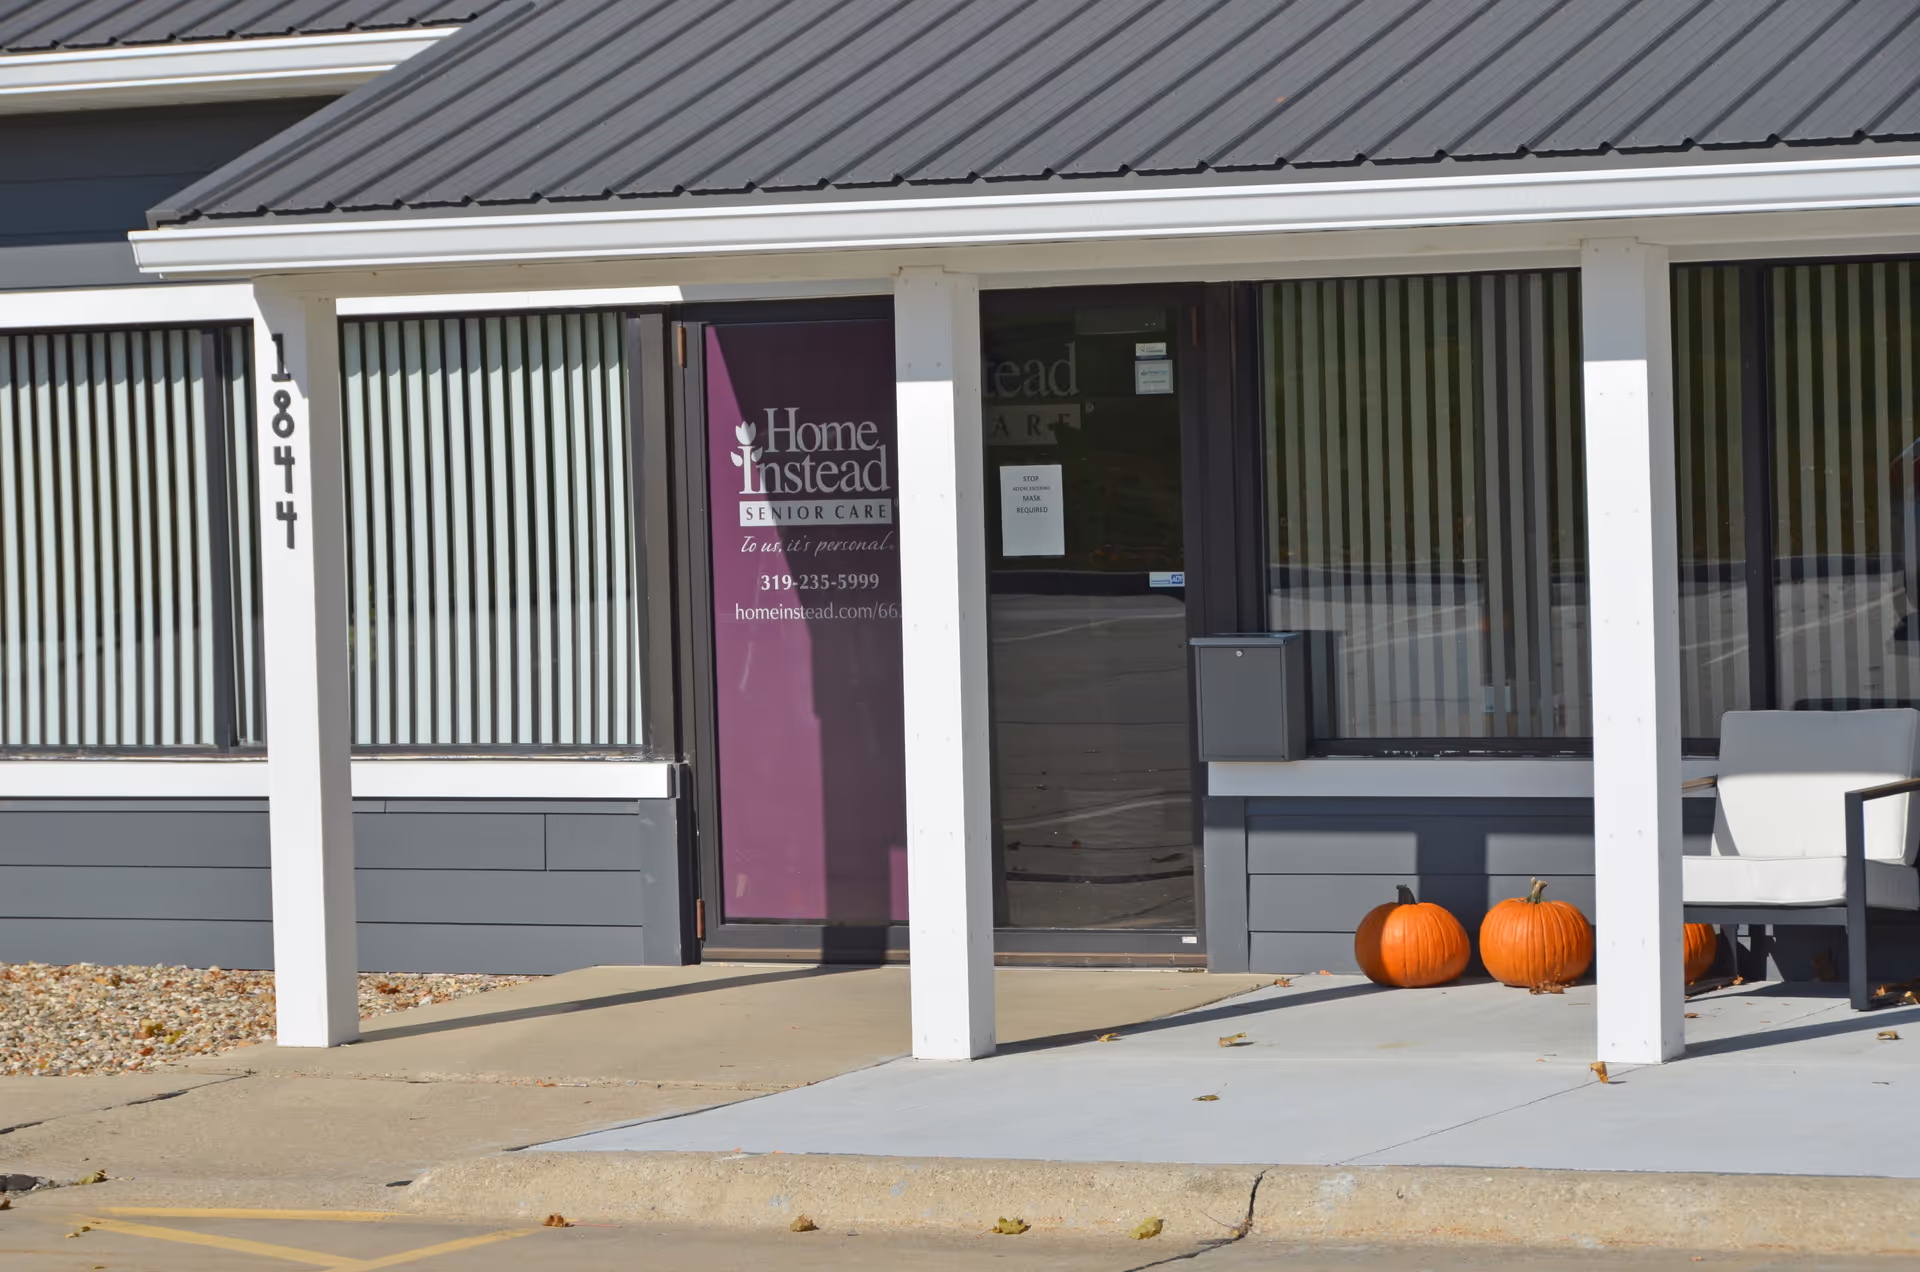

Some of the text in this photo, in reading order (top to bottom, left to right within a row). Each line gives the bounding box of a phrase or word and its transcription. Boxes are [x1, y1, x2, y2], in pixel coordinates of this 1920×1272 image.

[984, 339, 1081, 400] tead
[270, 333, 298, 550] 1844
[763, 407, 880, 453] Home
[738, 444, 891, 495] Instead
[746, 504, 887, 521] SENIOR CARE
[1016, 506, 1048, 514] REQUIRED
[741, 535, 757, 553] To
[787, 534, 811, 552] it's
[760, 573, 880, 591] 319-235-5999
